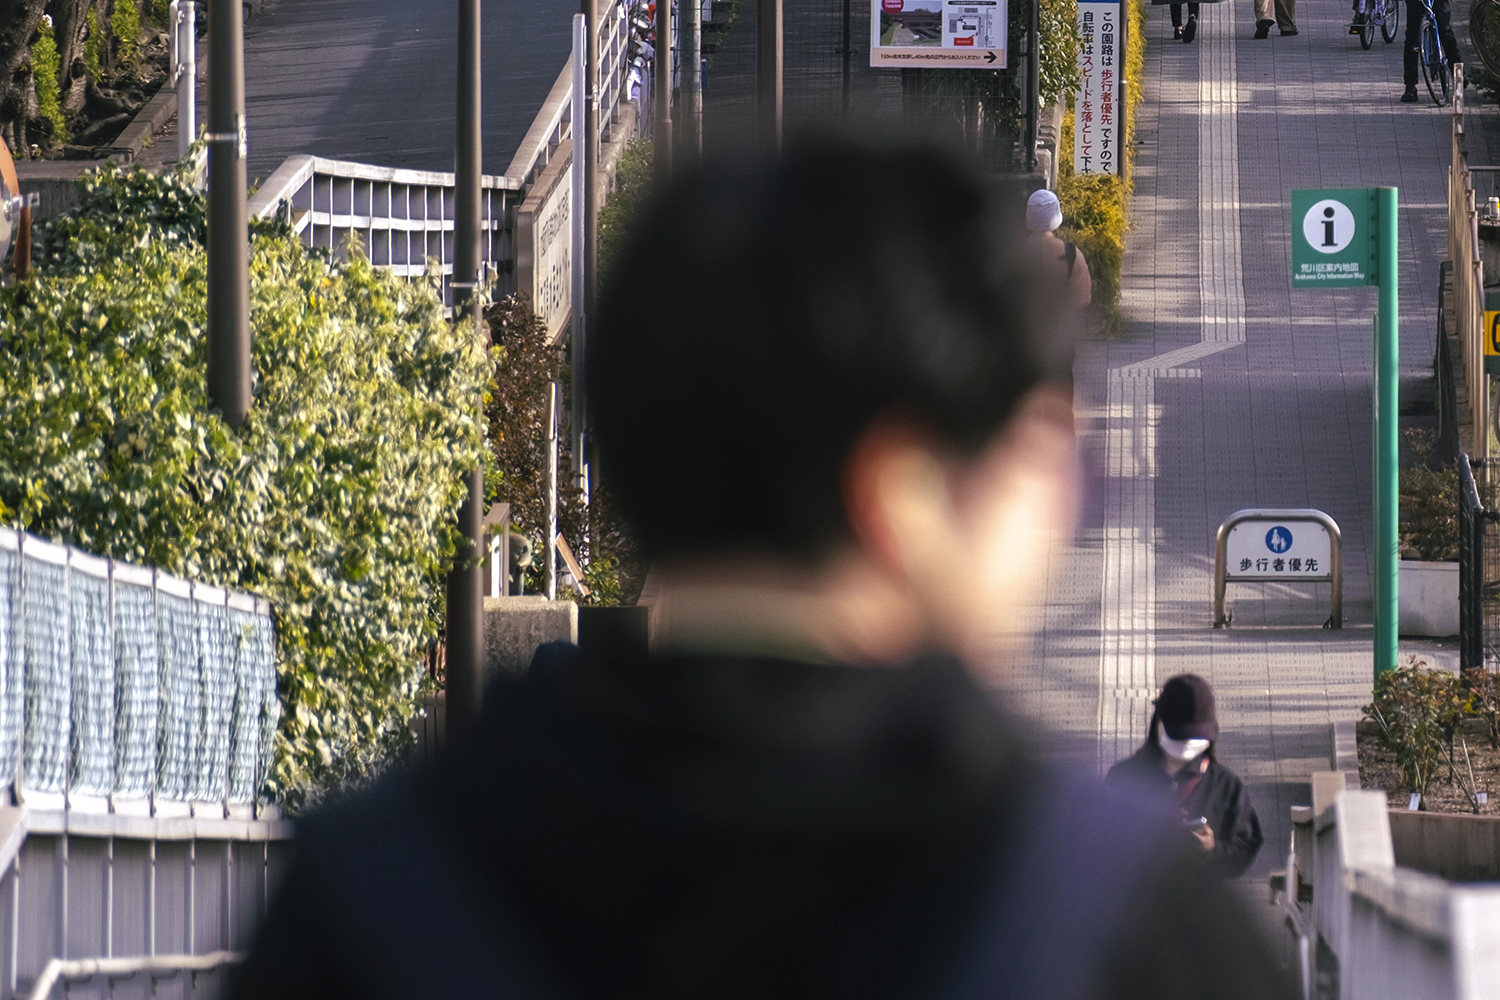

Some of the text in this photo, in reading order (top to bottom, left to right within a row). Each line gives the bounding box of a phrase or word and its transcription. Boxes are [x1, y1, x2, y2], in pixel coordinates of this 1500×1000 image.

[1239, 558, 1319, 572] 歩行者優先
